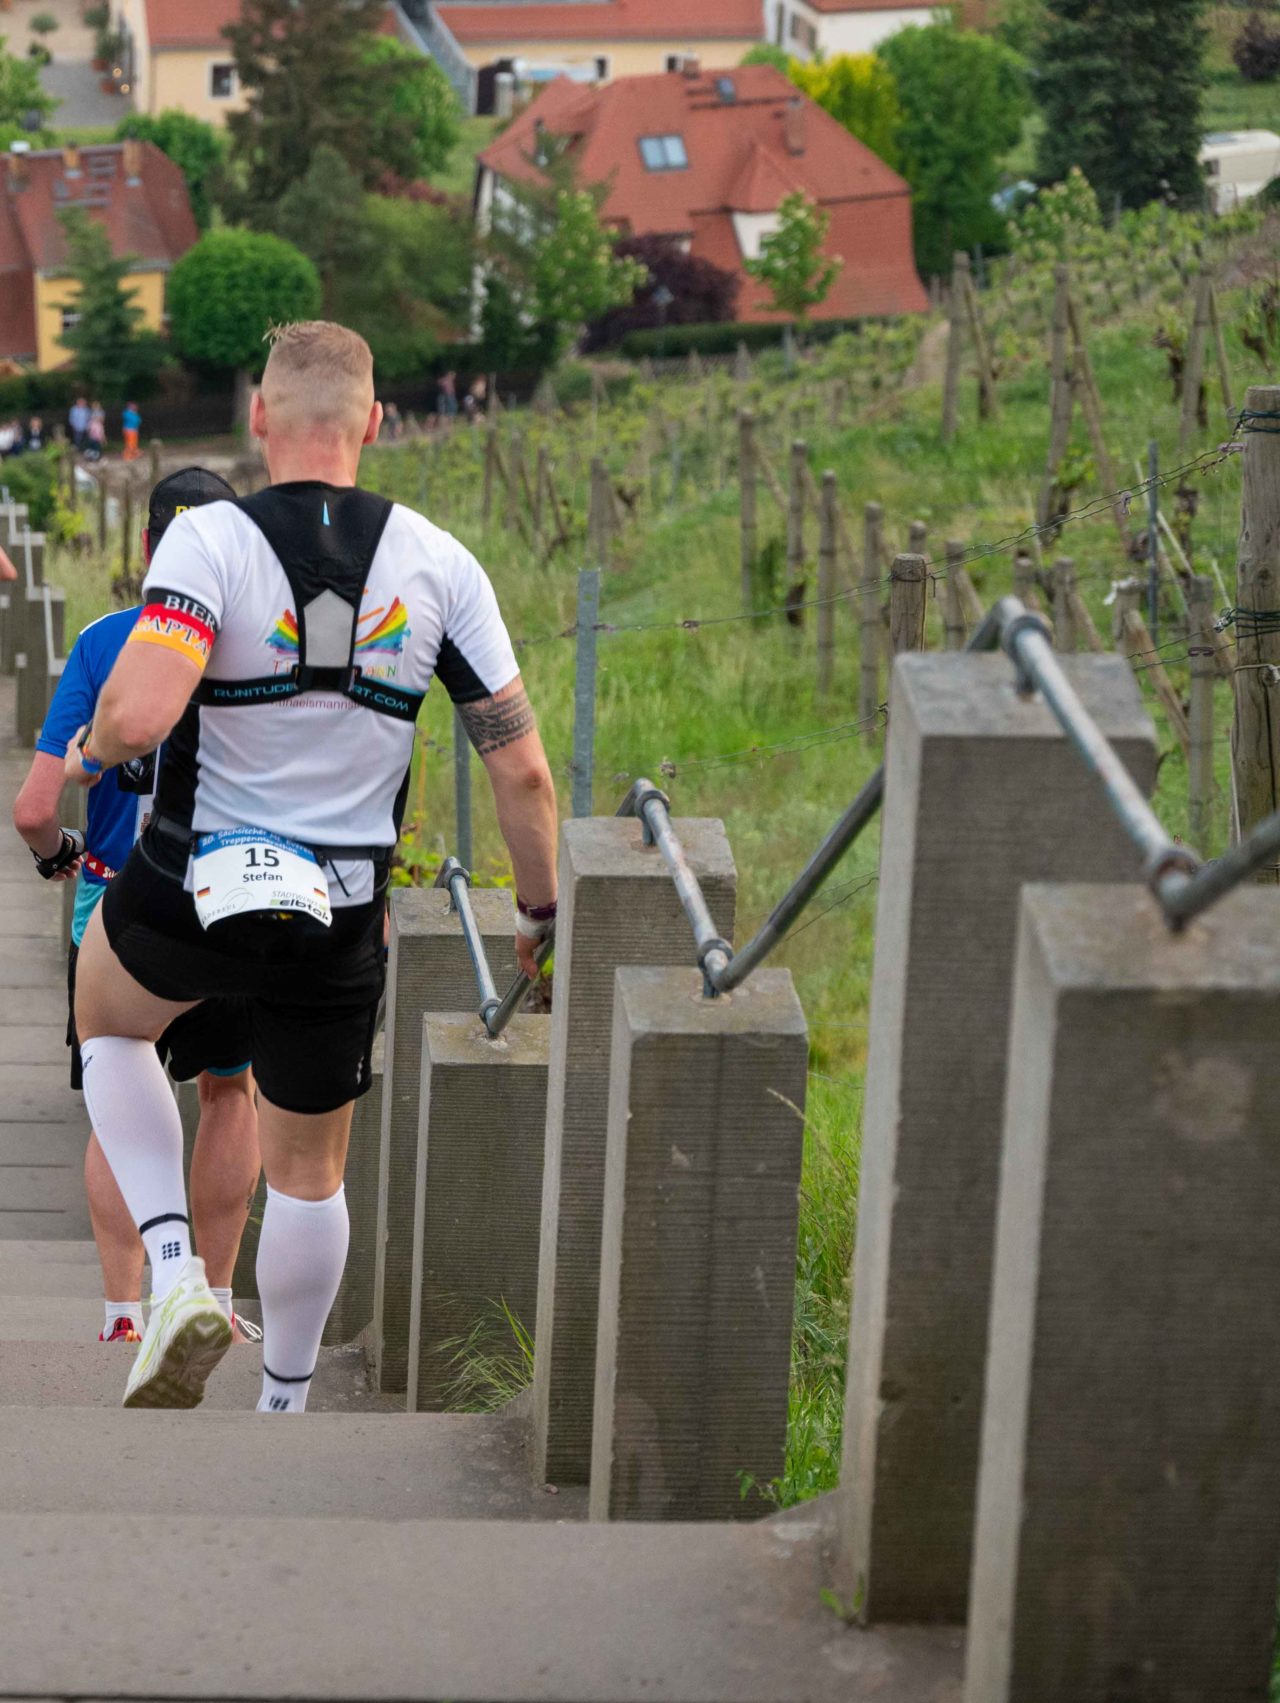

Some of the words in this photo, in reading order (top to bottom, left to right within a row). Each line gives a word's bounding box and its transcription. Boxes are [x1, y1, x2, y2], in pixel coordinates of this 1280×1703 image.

[164, 594, 216, 633] BIER
[134, 614, 211, 661] CAPTA
[244, 847, 280, 868] 15
[242, 873, 283, 884] Stefan
